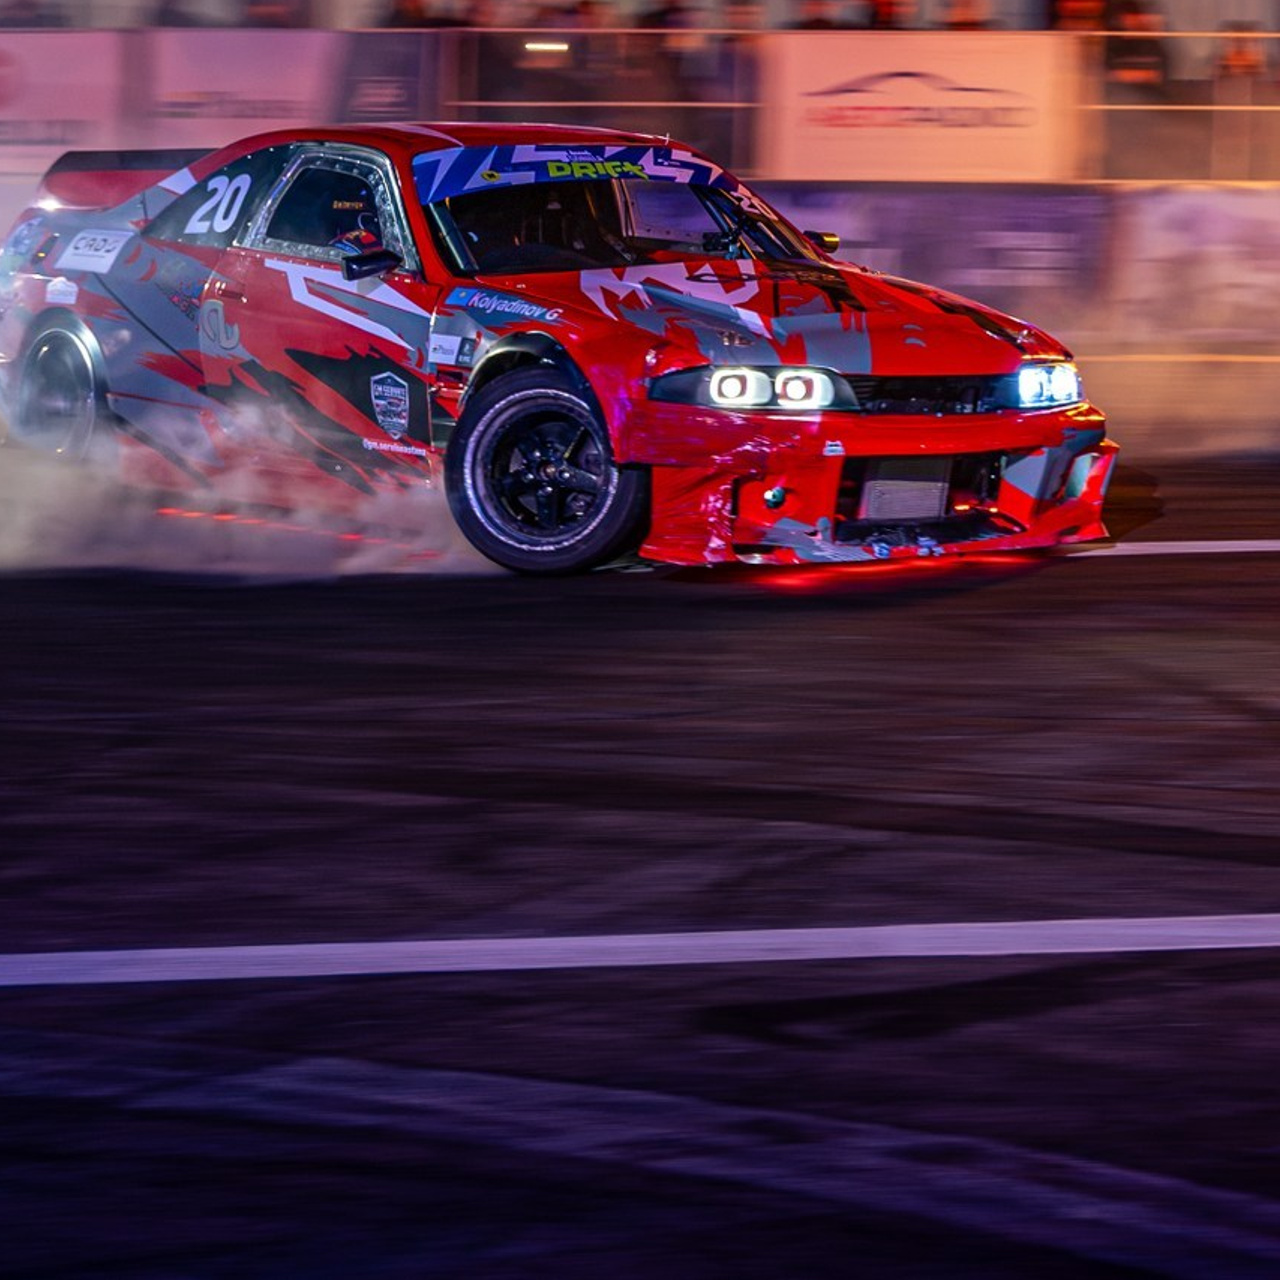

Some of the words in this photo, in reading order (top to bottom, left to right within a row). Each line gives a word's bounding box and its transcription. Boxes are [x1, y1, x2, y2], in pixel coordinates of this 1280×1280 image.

[547, 161, 650, 182] DRIFT
[184, 173, 253, 235] 20
[468, 292, 547, 317] Kolyadinov
[545, 307, 564, 320] G
